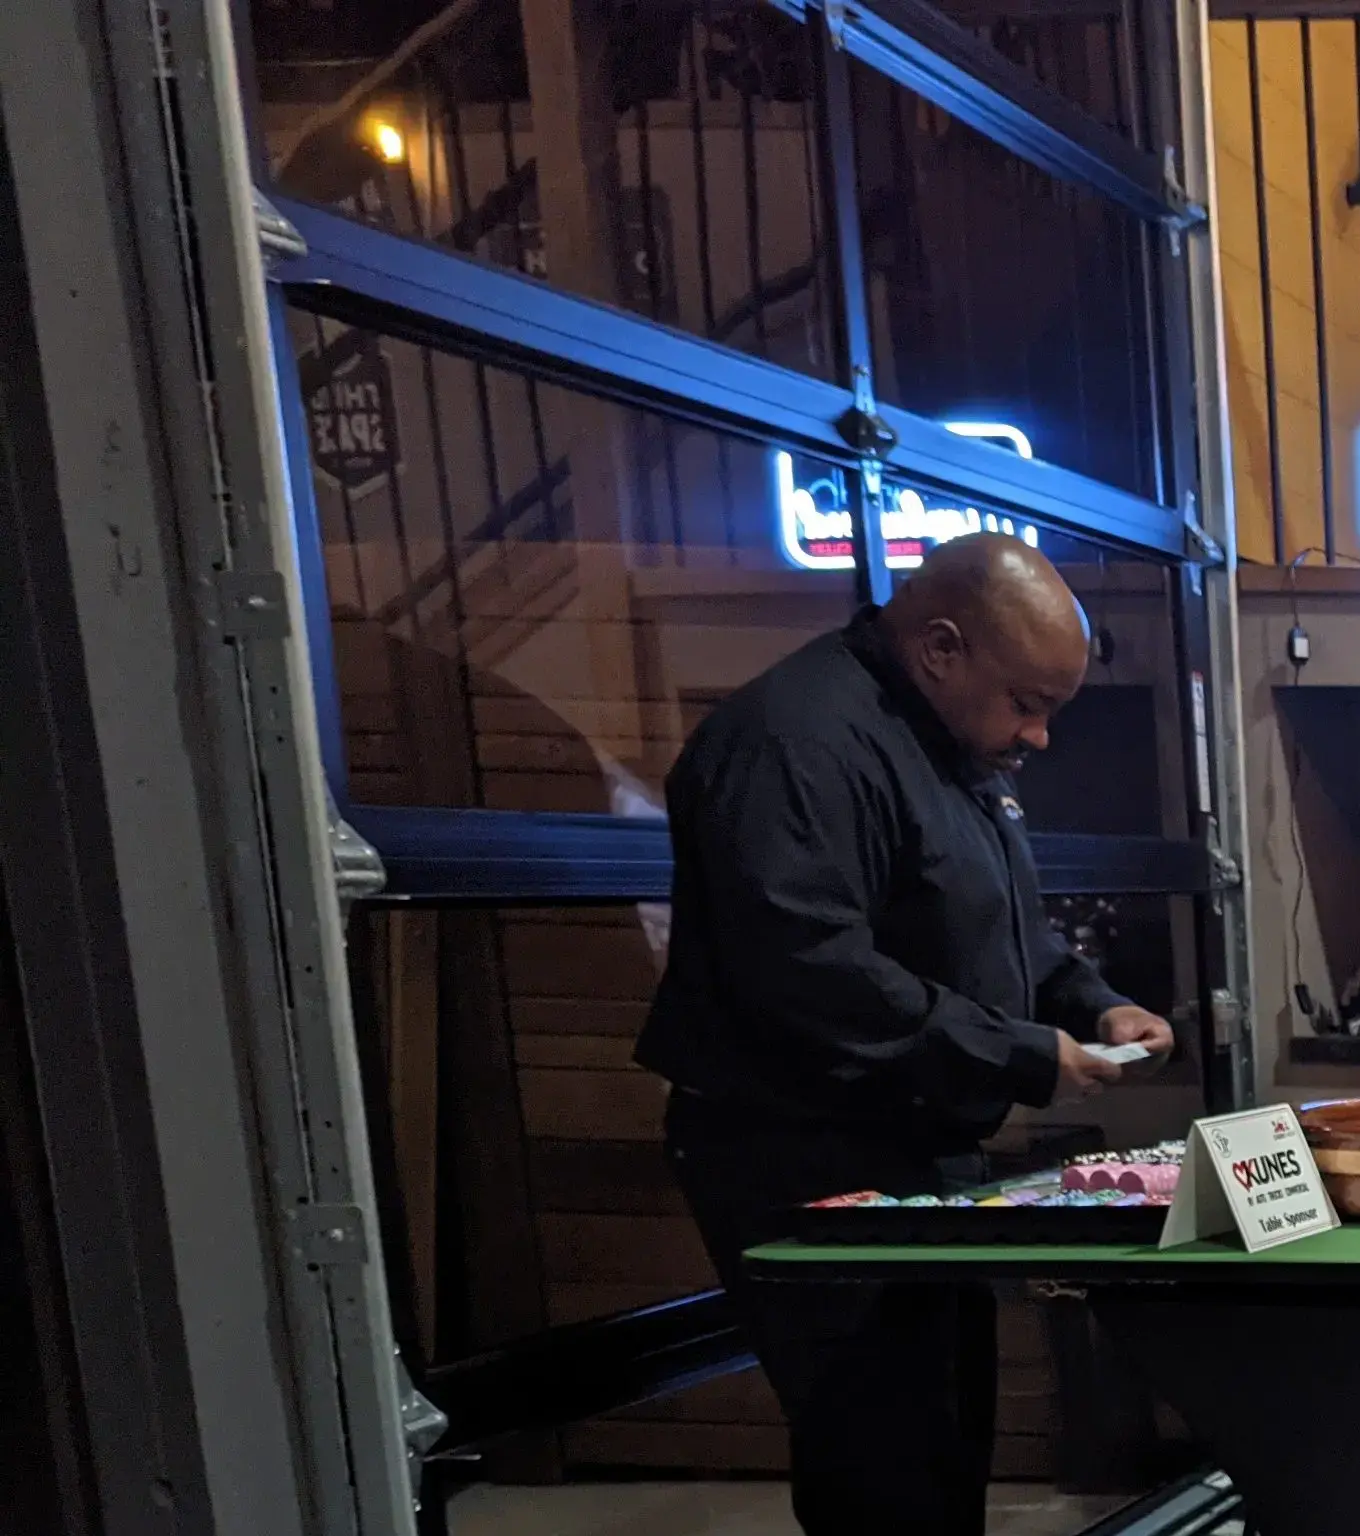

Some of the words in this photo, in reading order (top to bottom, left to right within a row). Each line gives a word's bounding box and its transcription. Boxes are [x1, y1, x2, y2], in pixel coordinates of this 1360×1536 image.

[1241, 1149, 1302, 1188] KUNES
[1259, 1217, 1284, 1234] Table
[1284, 1208, 1319, 1229] Sponsor
